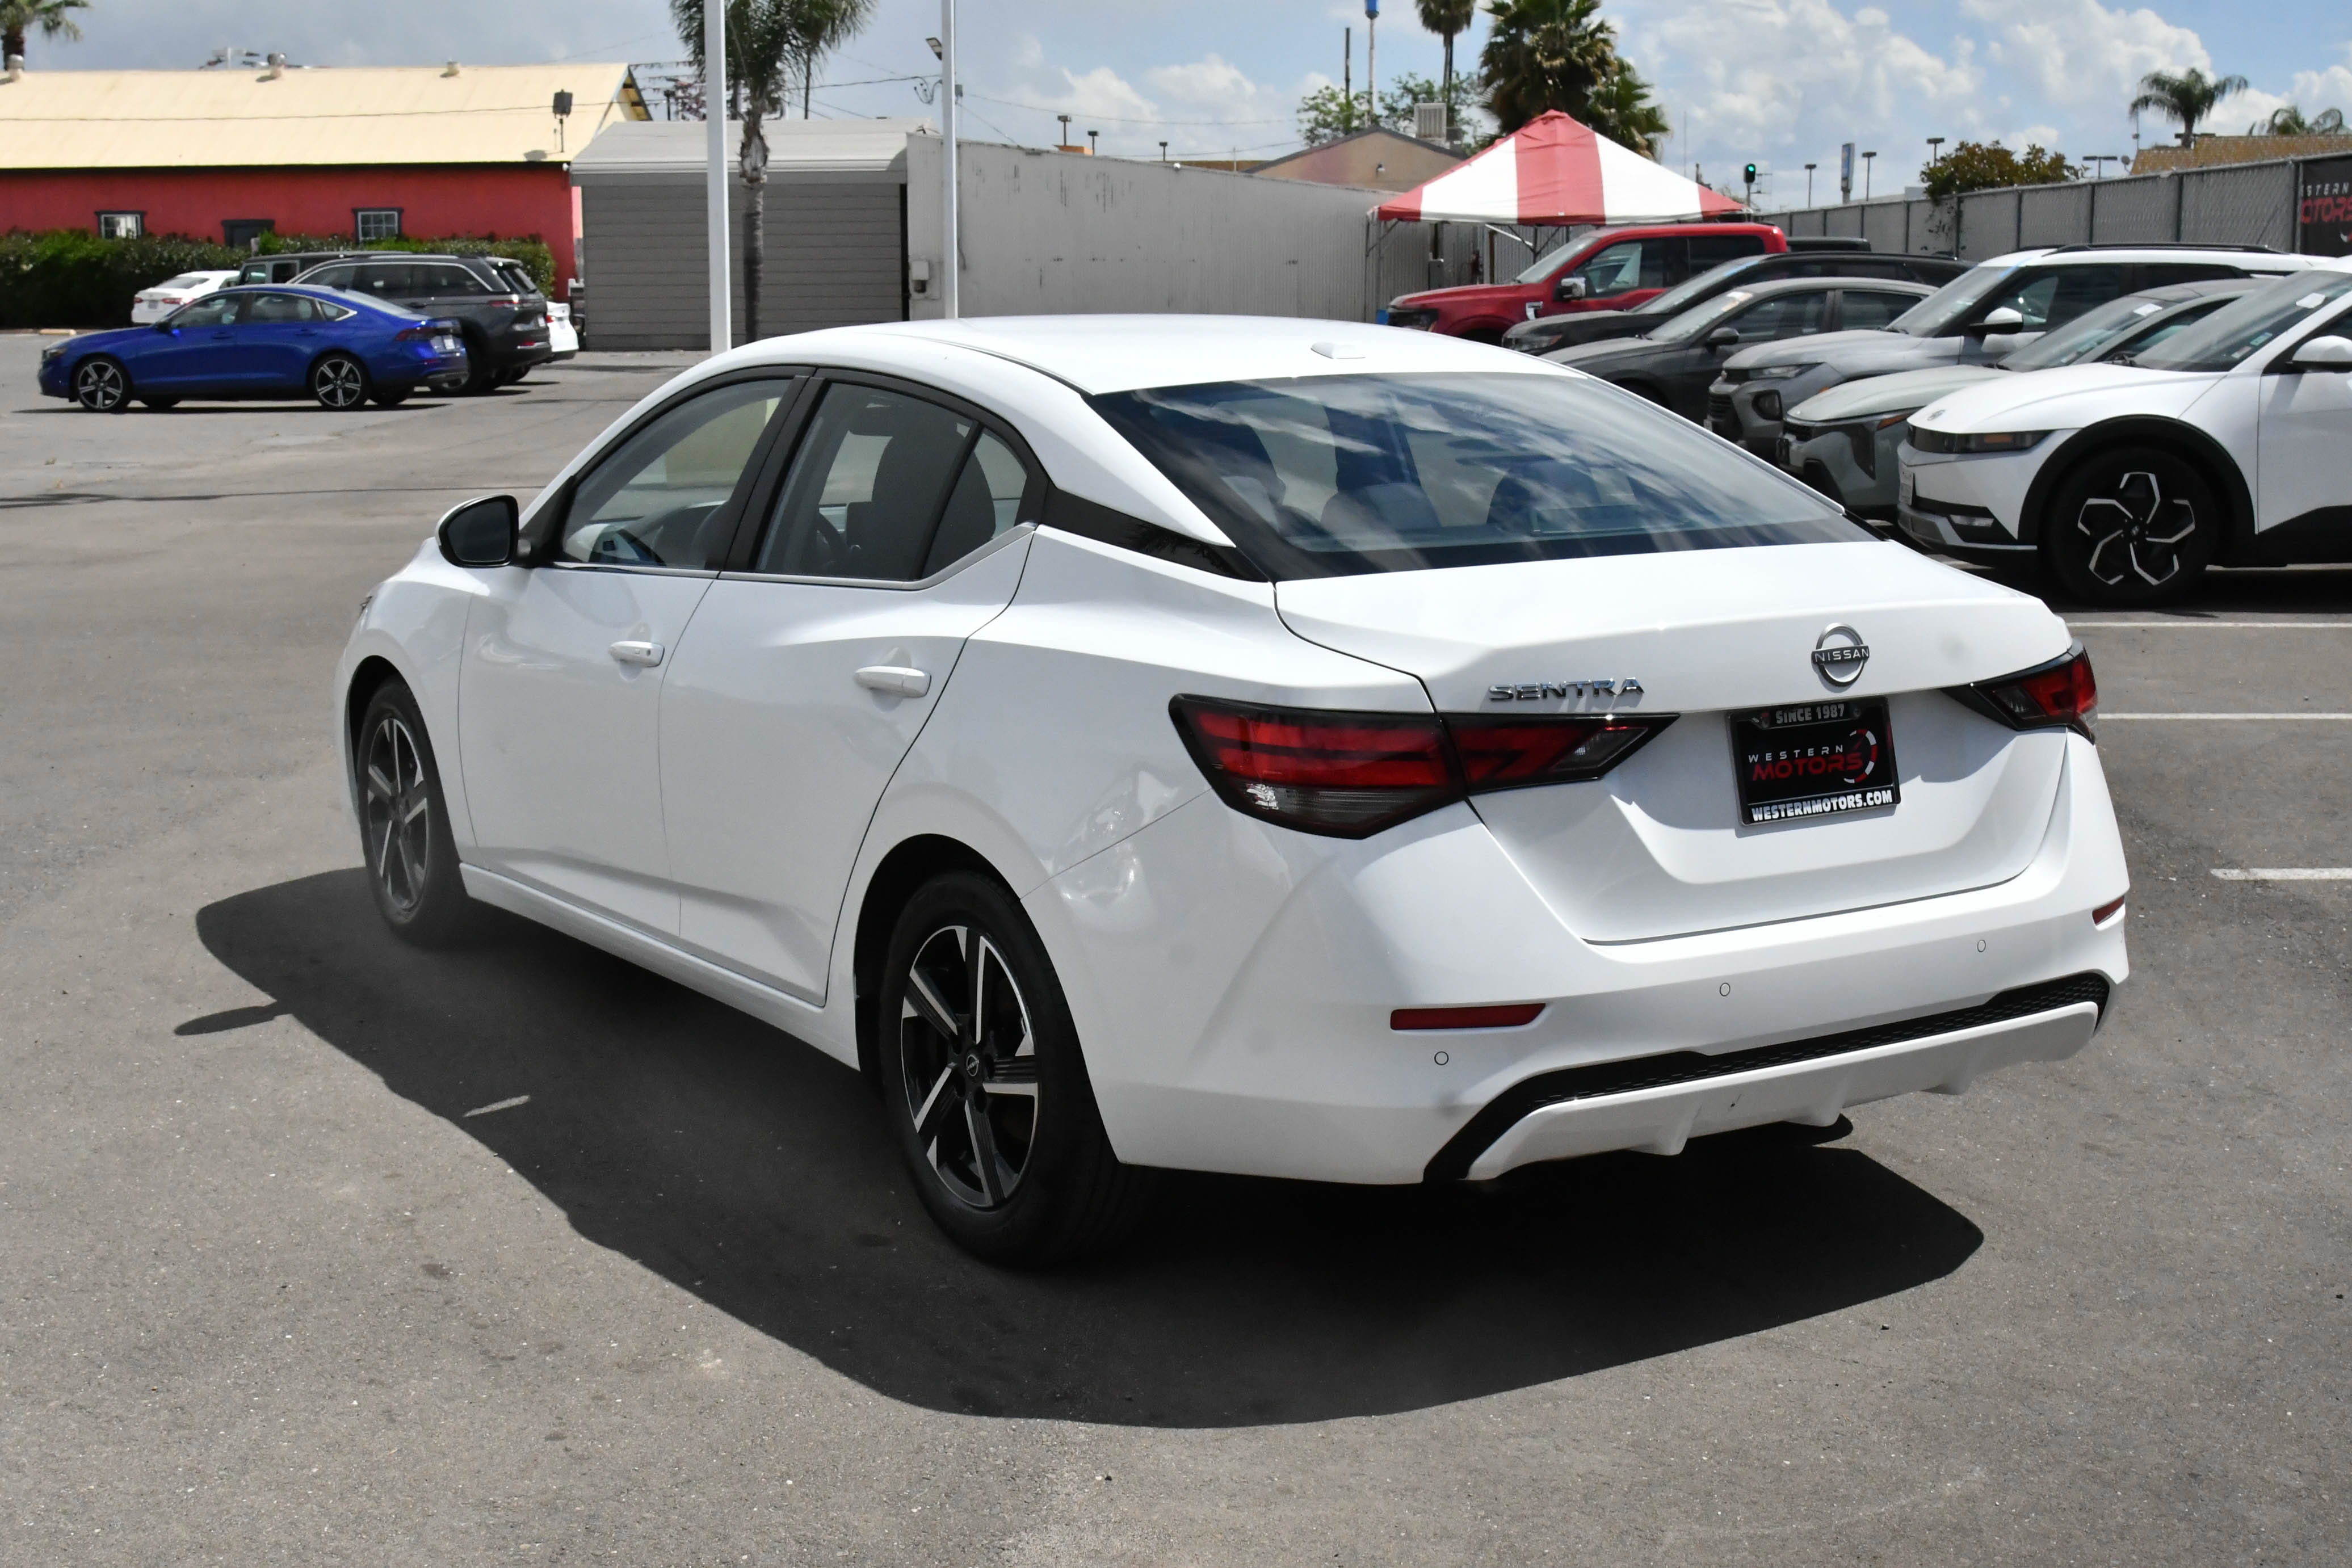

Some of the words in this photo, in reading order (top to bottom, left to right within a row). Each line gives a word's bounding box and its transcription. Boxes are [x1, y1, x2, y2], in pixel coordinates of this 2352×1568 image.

[1815, 648, 1869, 662] NISSAN
[1488, 677, 1645, 700] SENTRA
[1775, 707, 1812, 724] SINCE
[1816, 703, 1845, 720] 1987
[1748, 744, 1843, 763] WESTERN
[1752, 753, 1863, 781] MOTORS
[1752, 789, 1893, 822] WESTERNMOTORS.COM
